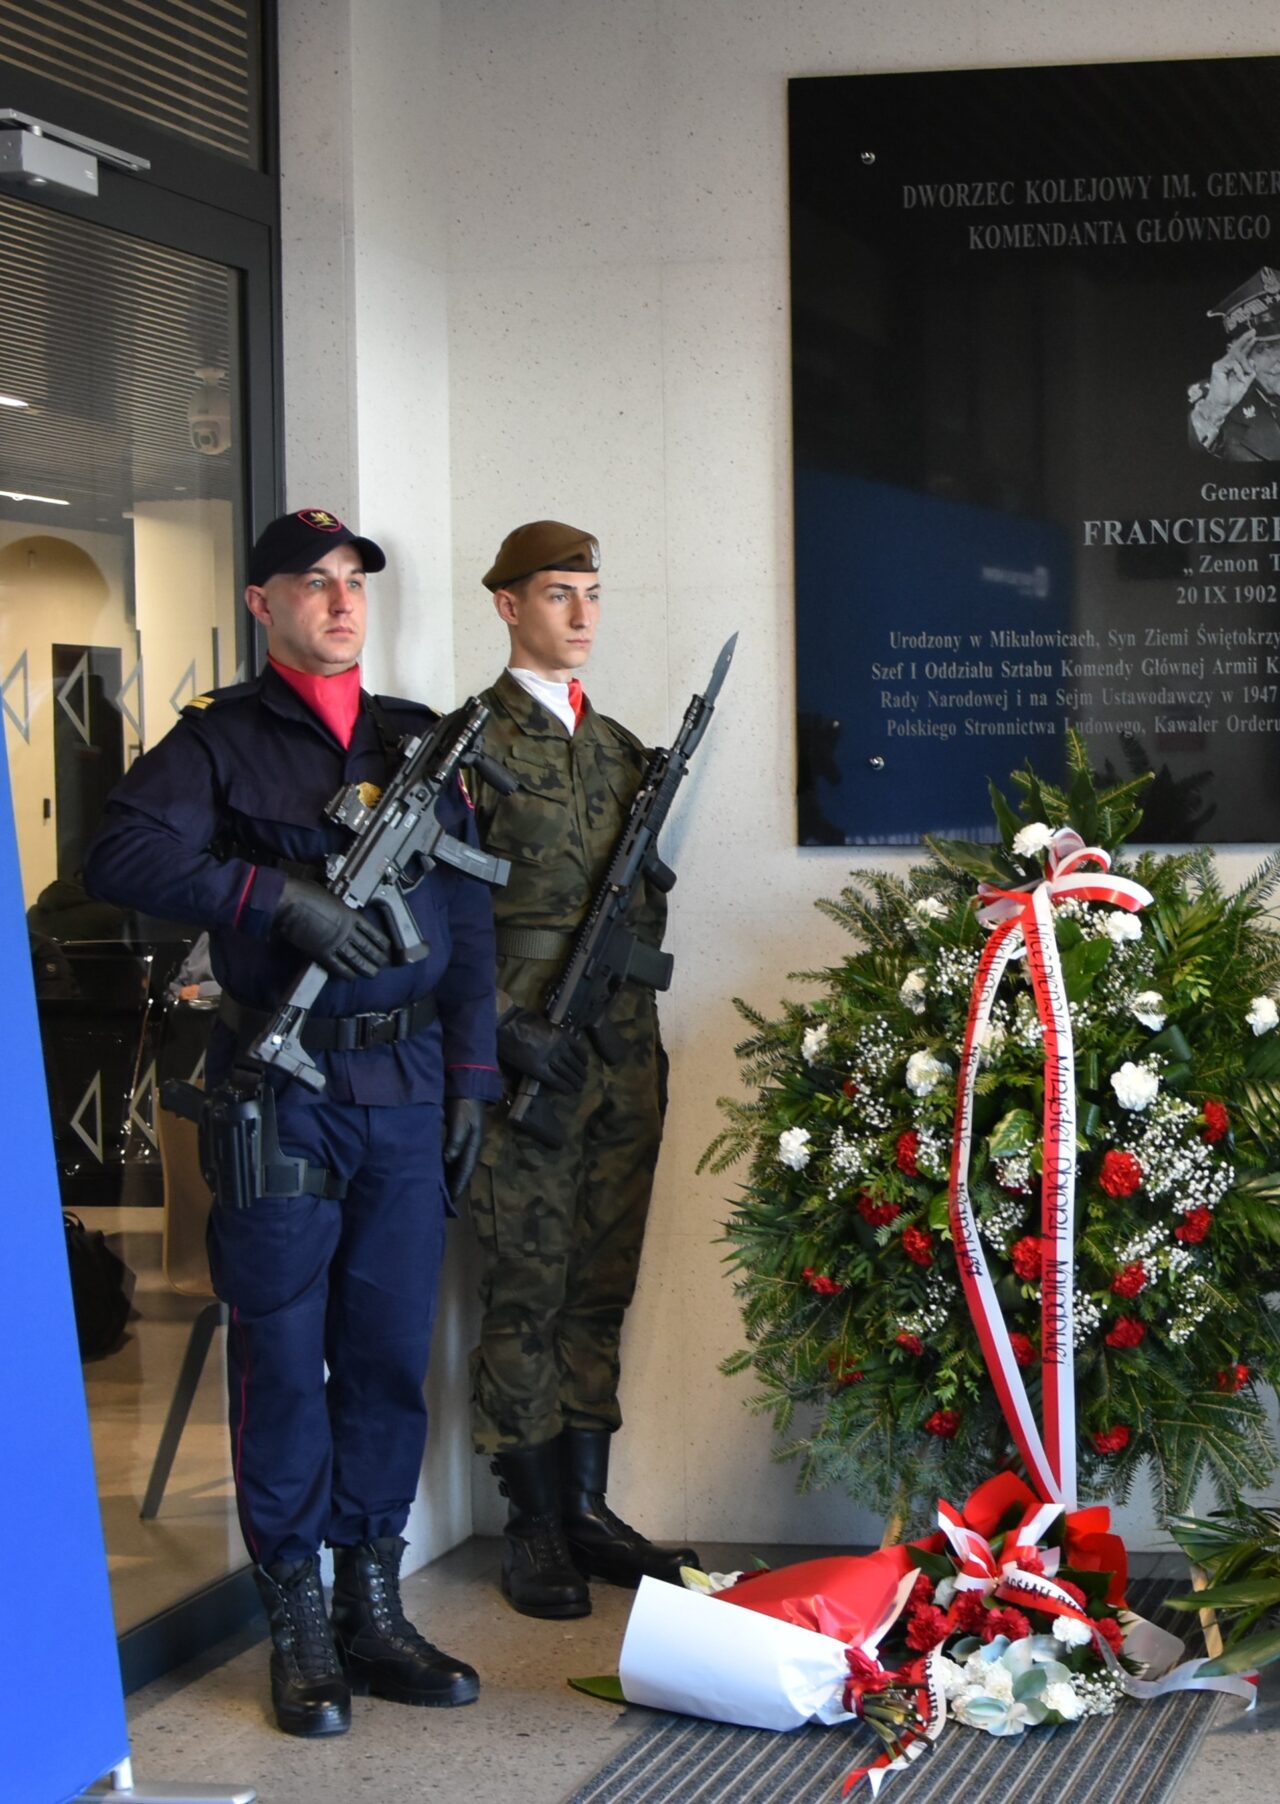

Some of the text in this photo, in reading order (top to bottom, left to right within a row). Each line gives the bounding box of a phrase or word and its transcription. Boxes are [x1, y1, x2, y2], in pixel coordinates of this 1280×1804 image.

[903, 181, 1015, 209] DWORZEC
[1025, 175, 1152, 204] KOLEJOWY
[1163, 174, 1197, 199] IM.
[969, 219, 1127, 250] KOMENDANTA
[1136, 211, 1271, 244] GŁÓWNEGO
[1200, 481, 1278, 501] Generał
[1176, 586, 1198, 605] 20
[1204, 585, 1228, 604] IX
[1234, 584, 1277, 603] 1902
[889, 631, 963, 652] Urodzony
[970, 634, 982, 649] w
[990, 629, 1100, 650] Mikułowicach,
[1108, 629, 1136, 650] Syn
[1145, 628, 1189, 646] Ziemi
[871, 661, 904, 681] Szef
[911, 662, 917, 680] I
[925, 660, 993, 680] Oddziału
[1001, 660, 1053, 679] Sztabu
[1061, 658, 1134, 681] Komendy
[1141, 657, 1205, 680] Głównej
[1212, 656, 1258, 675] Armii
[880, 690, 919, 712] Rady
[928, 689, 1009, 711] Narodowej
[1016, 689, 1022, 708] i
[1030, 691, 1048, 707] na
[1056, 688, 1093, 711] Sejm
[1102, 687, 1213, 708] Ustawodawczy
[1221, 689, 1234, 705] w
[1243, 685, 1278, 704] 1947
[887, 719, 957, 741] Polskiego
[965, 717, 1056, 737] Stronnictwa
[1065, 715, 1147, 738] Ludowego,
[1154, 714, 1219, 734] Kawaler
